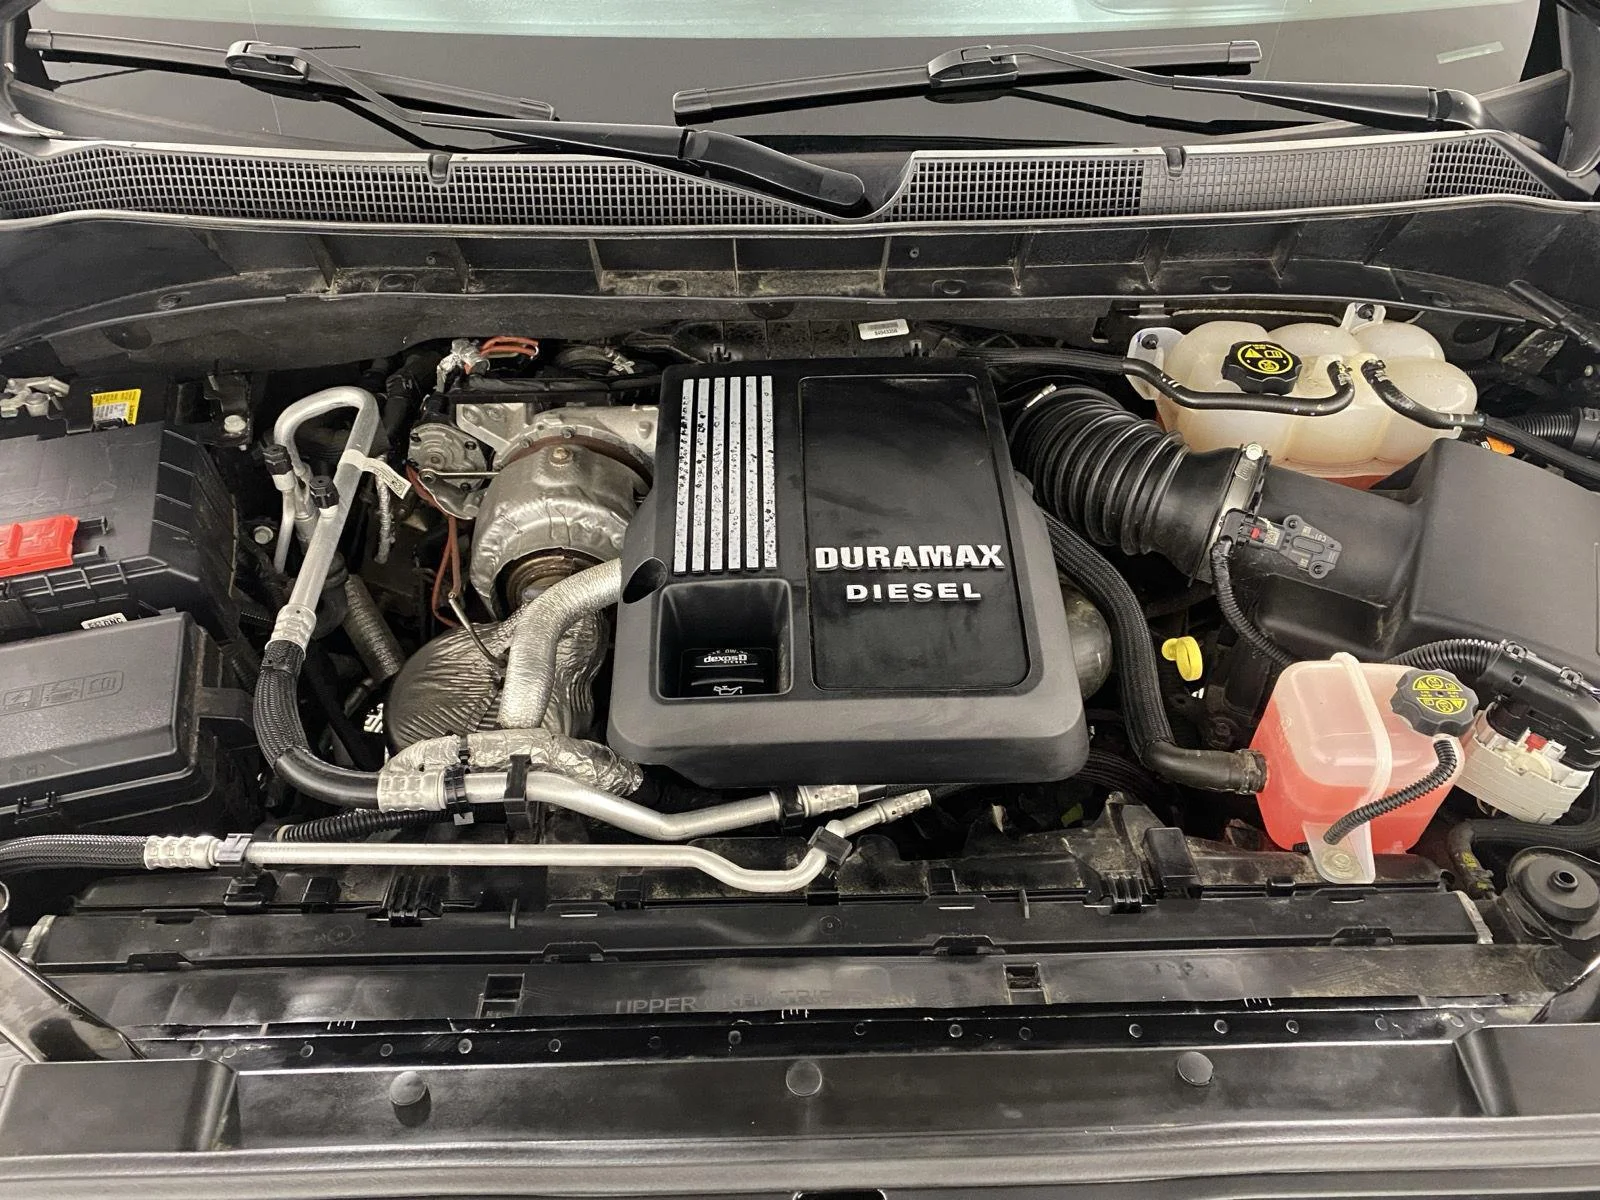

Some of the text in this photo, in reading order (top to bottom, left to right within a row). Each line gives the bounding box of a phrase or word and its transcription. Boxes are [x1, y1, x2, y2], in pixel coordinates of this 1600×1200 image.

[815, 544, 1005, 570] DURAMAX
[846, 582, 982, 602] DIESEL
[616, 996, 696, 1013] UPPER
